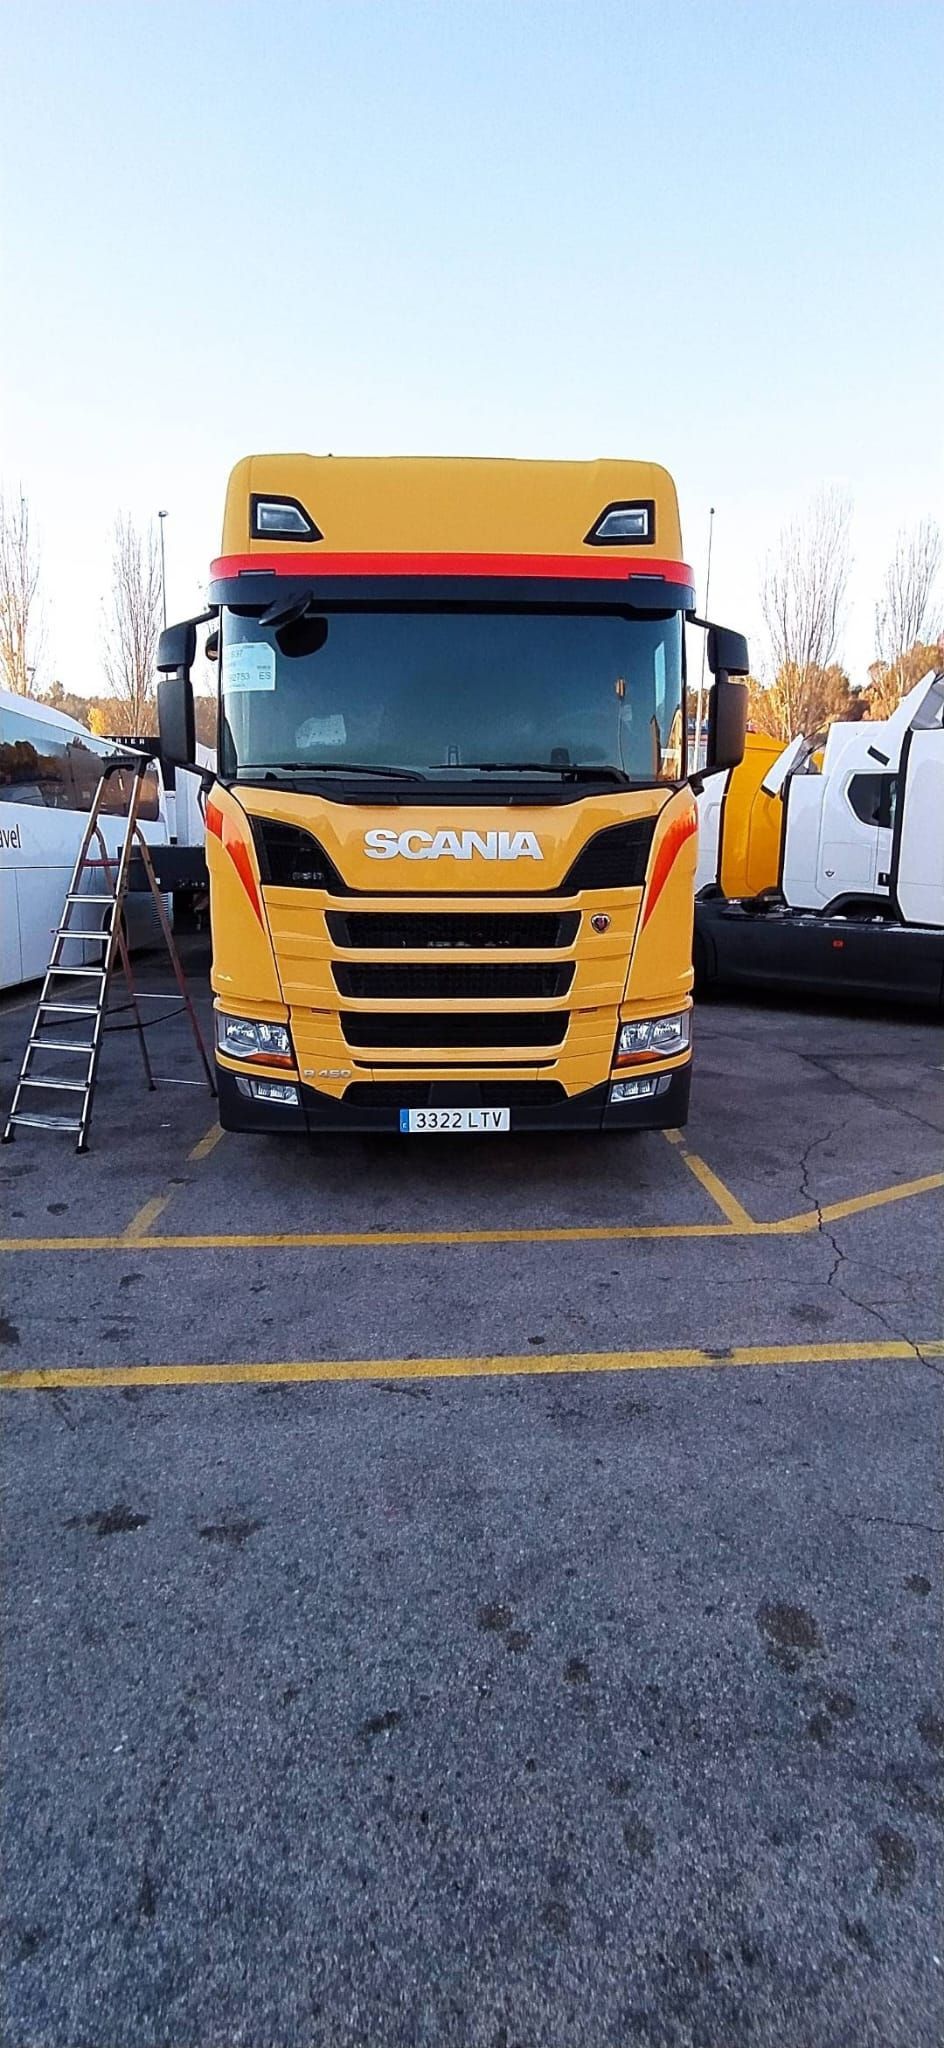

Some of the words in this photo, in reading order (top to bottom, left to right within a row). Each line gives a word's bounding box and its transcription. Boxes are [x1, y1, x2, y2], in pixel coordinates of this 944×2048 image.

[259, 671, 271, 680] ES
[364, 829, 544, 860] SCANIA
[303, 1069, 316, 1078] R
[317, 1069, 352, 1079] 450
[416, 1112, 462, 1128] 3322
[468, 1112, 502, 1128] LTV
